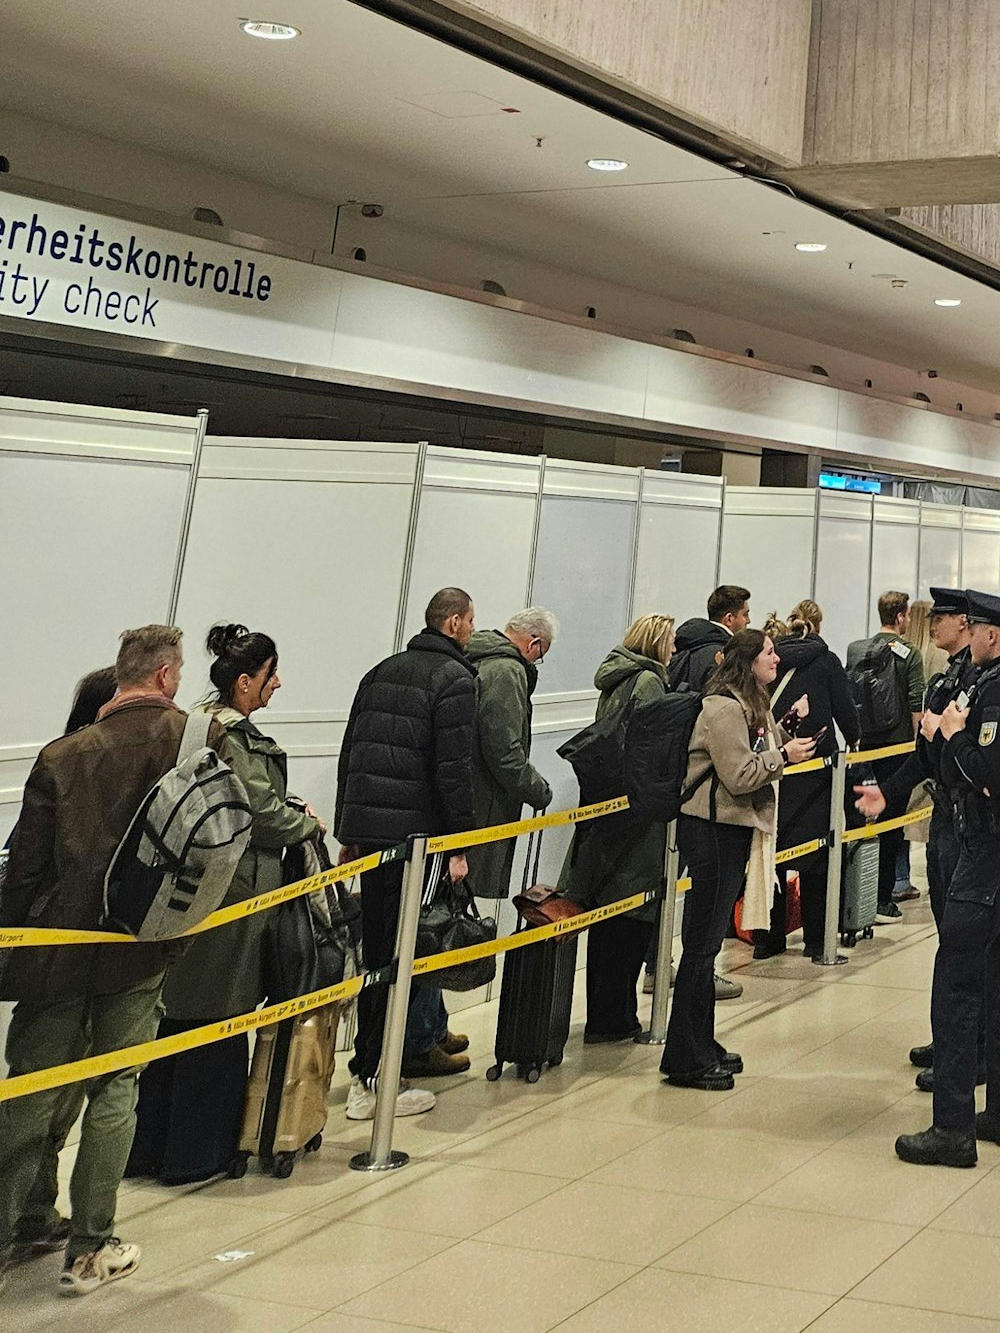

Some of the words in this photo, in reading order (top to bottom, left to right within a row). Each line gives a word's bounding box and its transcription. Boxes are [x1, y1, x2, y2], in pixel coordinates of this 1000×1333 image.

[0, 213, 272, 302] rheitskontrolle
[64, 276, 160, 327] check
[258, 1011, 276, 1022] Airport
